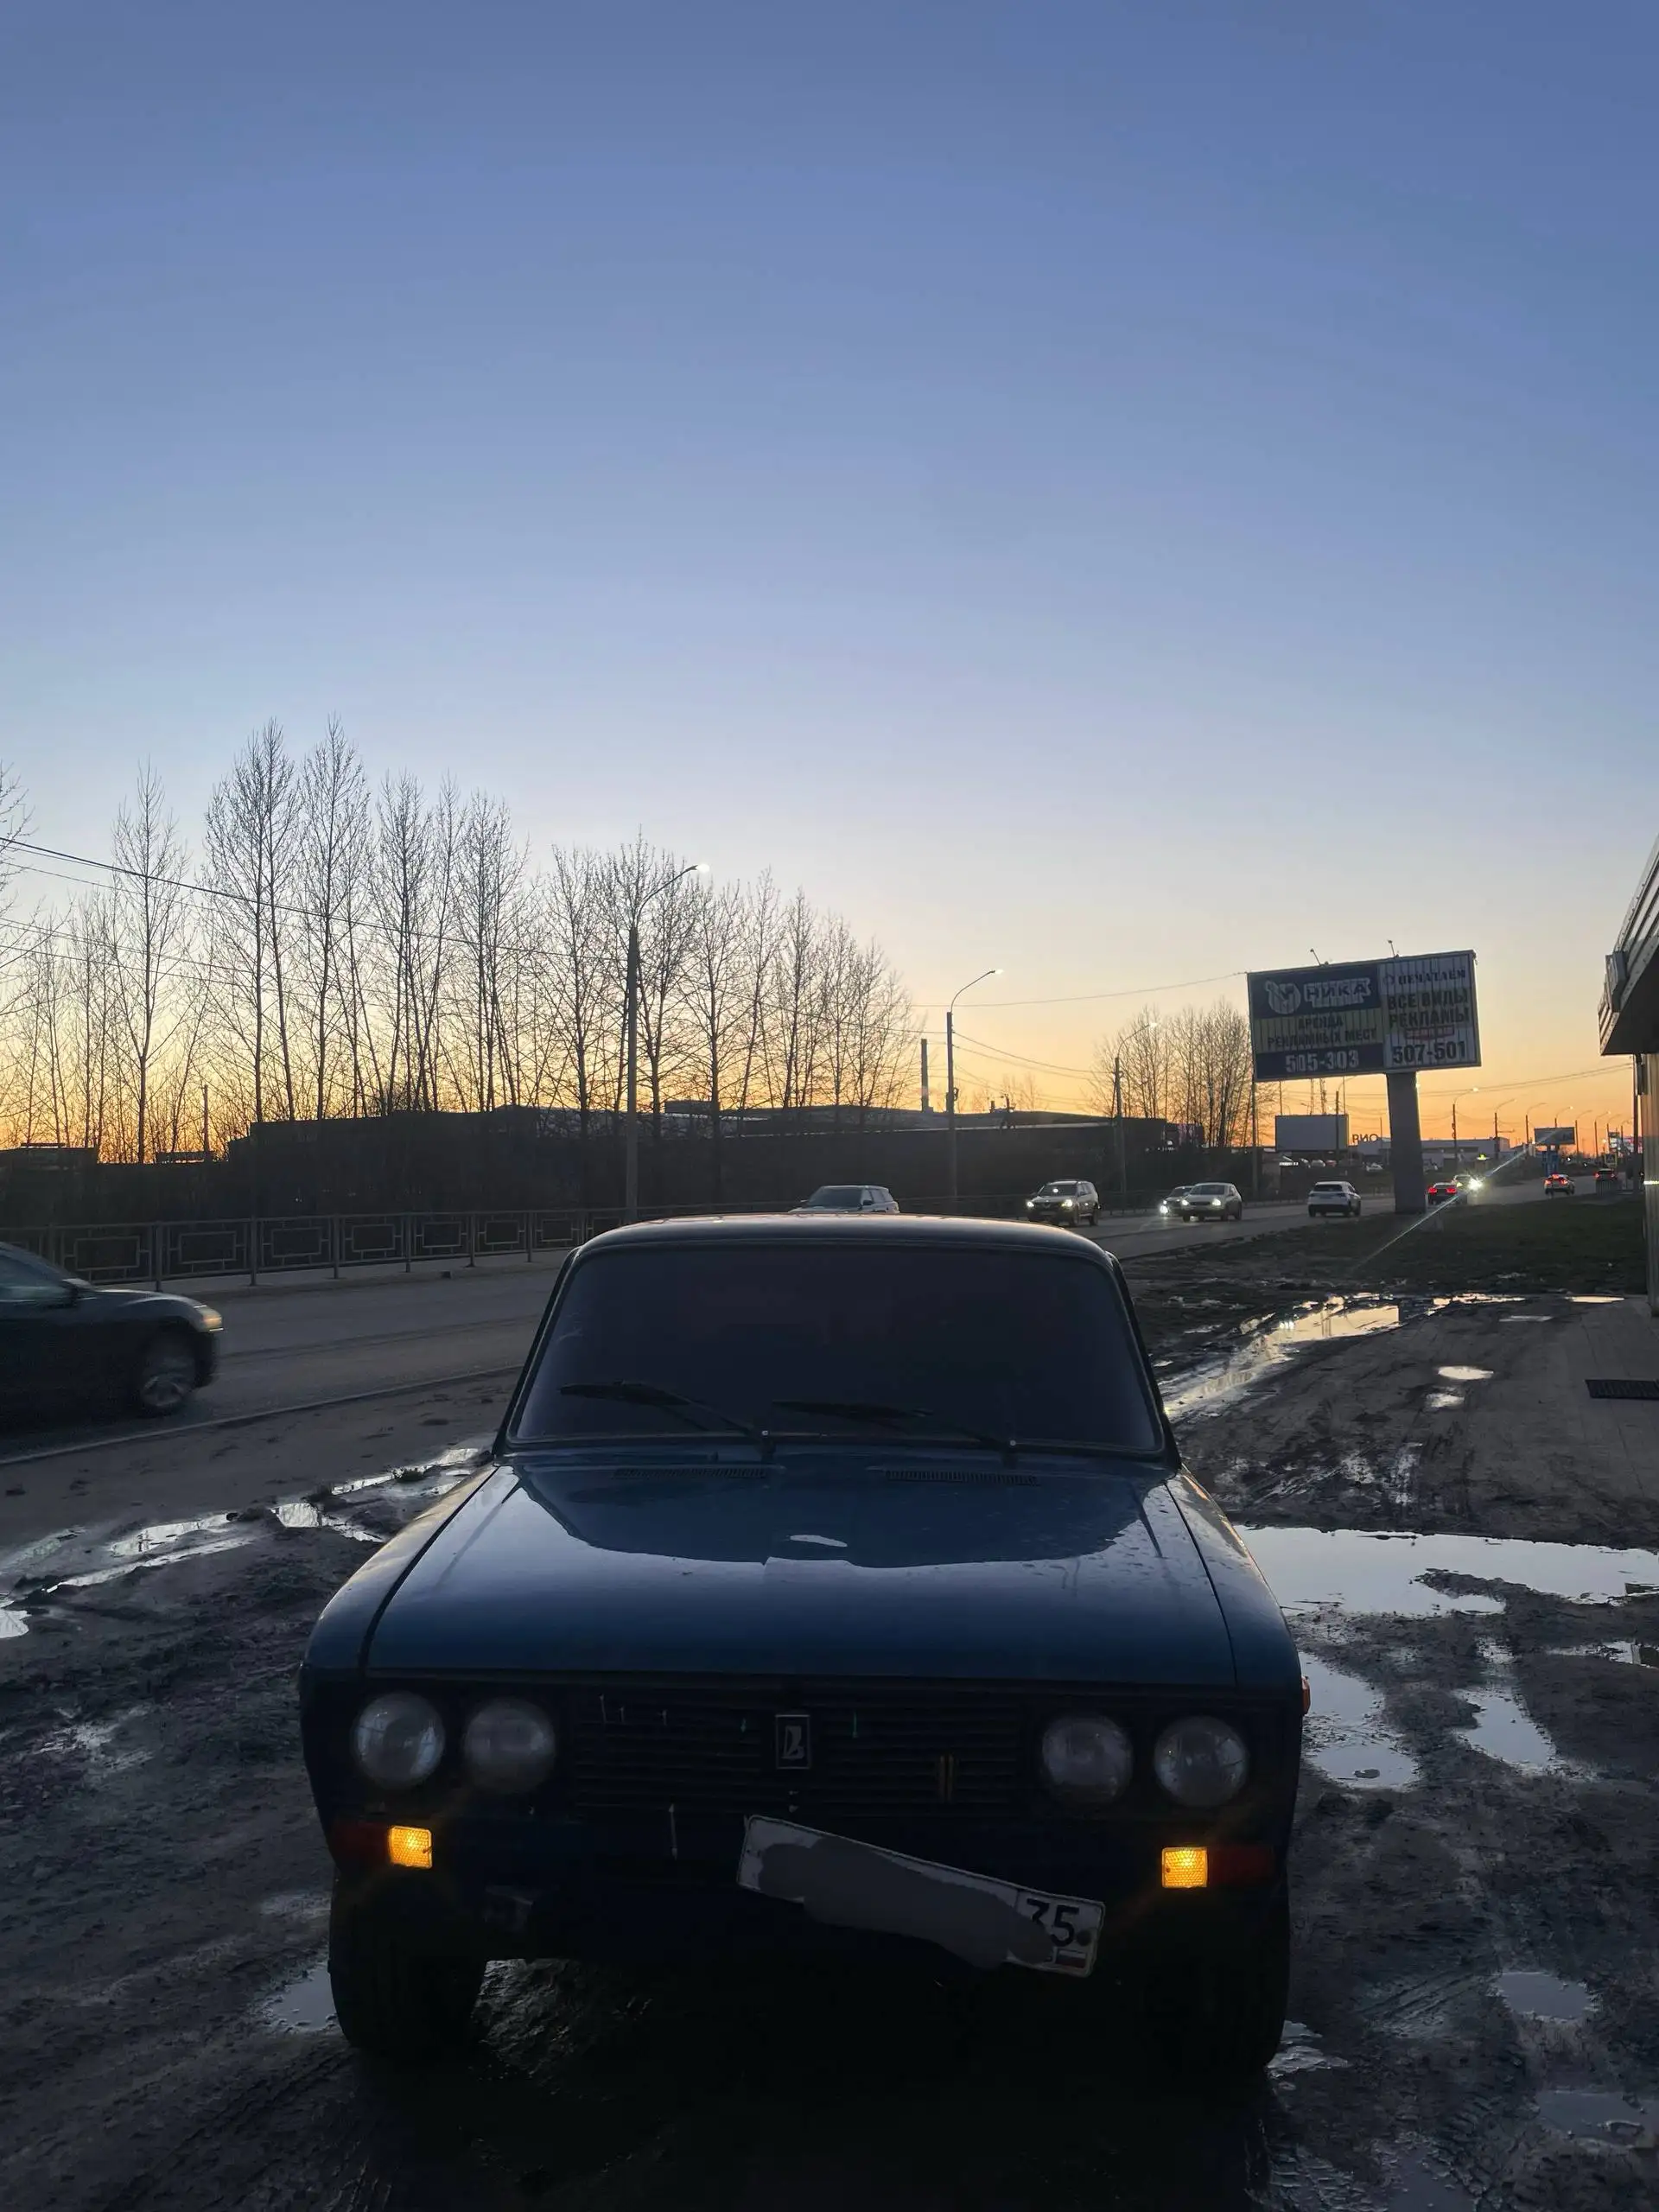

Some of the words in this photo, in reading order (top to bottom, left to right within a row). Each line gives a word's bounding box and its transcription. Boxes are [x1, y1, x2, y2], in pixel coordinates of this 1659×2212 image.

[1398, 969, 1466, 985] ПЕЧАТАЕМ
[1306, 983, 1368, 1000] НИКА
[1388, 992, 1417, 1010] ВСЕ
[1421, 988, 1469, 1007] ВИДЫ
[1298, 1014, 1344, 1030] АРЕНДА
[1389, 1007, 1470, 1028] РЕКЛАМЫ
[1267, 1030, 1342, 1048] РЕКЛАМНЫХ
[1344, 1027, 1377, 1042] МЕСТ
[1285, 1050, 1359, 1073] 505-303
[1392, 1040, 1466, 1064] 507-501
[1352, 1133, 1378, 1143] РИО
